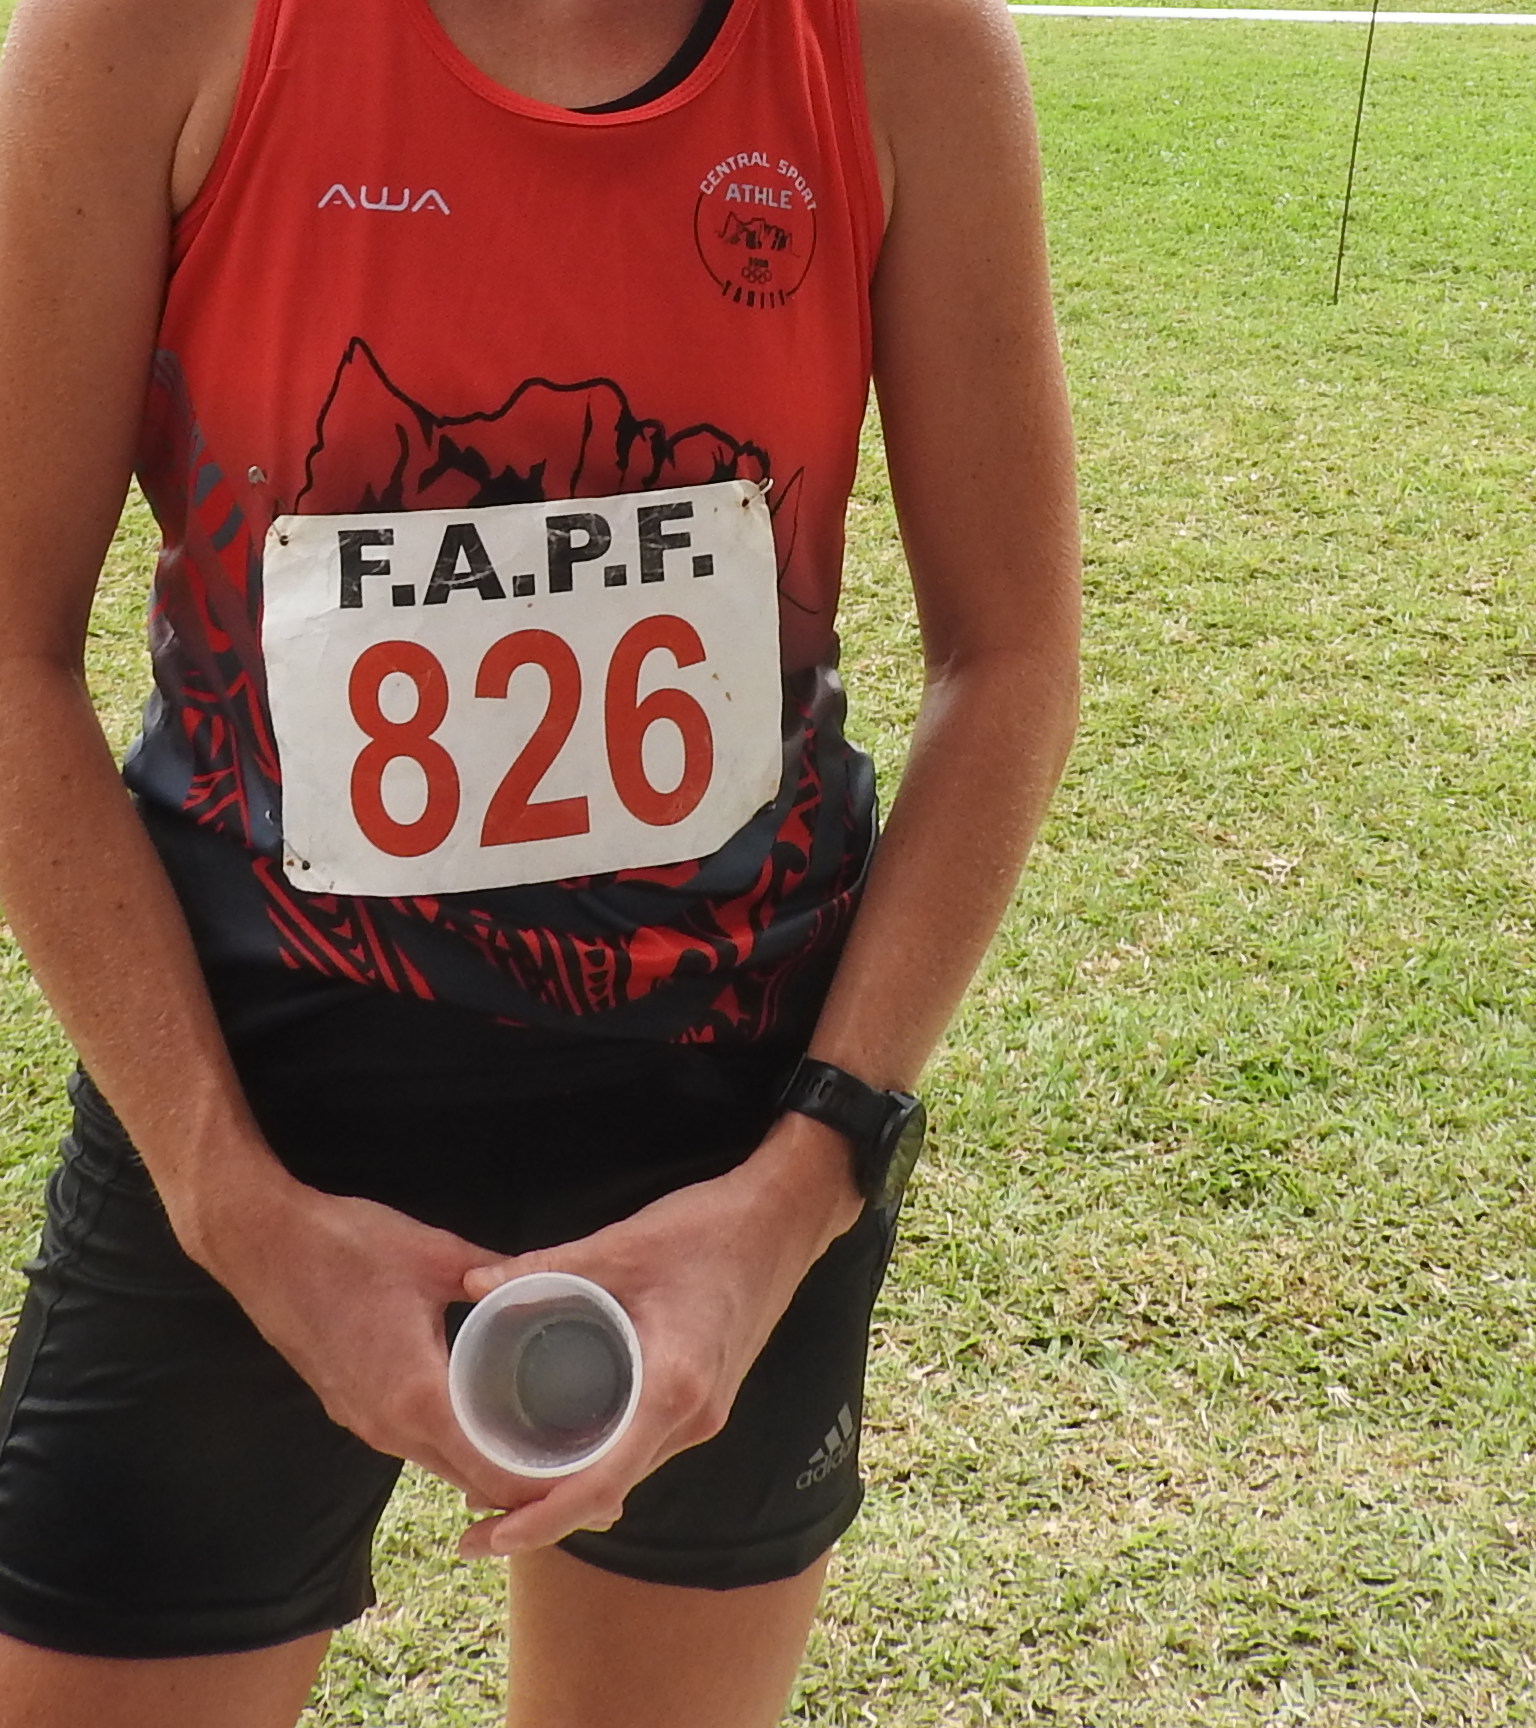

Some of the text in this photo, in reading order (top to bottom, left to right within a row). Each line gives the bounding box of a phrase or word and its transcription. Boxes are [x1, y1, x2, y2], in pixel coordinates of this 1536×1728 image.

[317, 183, 451, 215] AWA
[699, 151, 818, 211] CENTRAL SPORT
[724, 182, 794, 210] ATHLE
[336, 500, 715, 610] F.A.P.F.
[347, 613, 714, 859] 826
